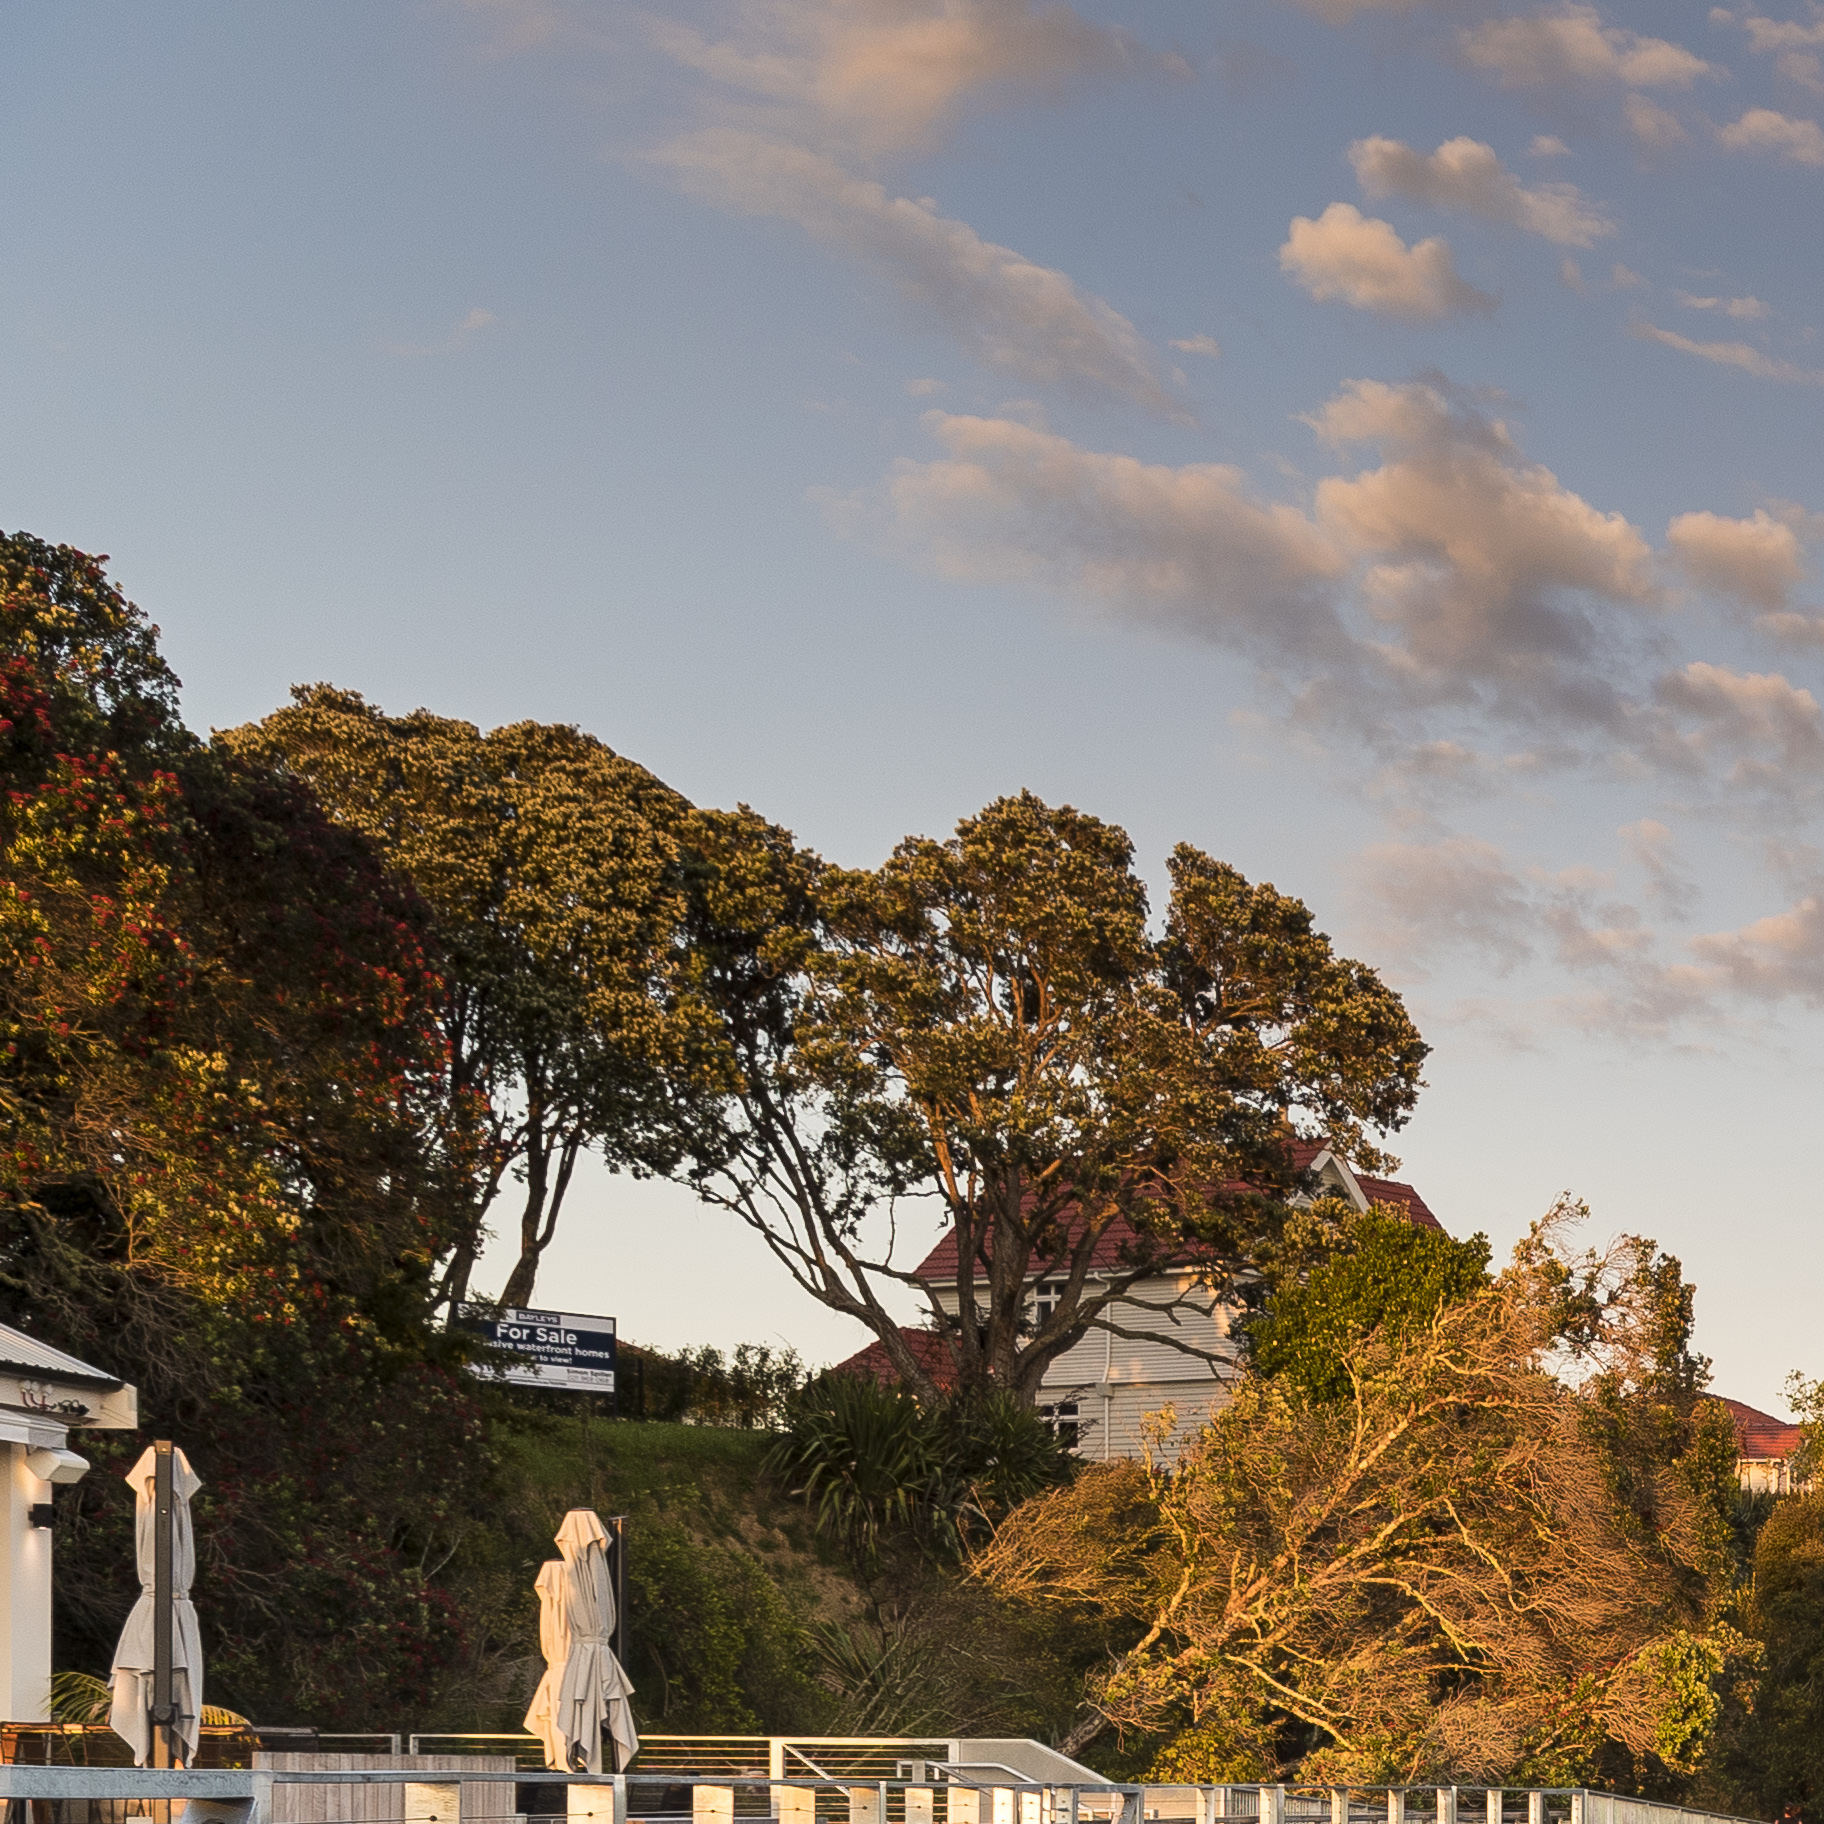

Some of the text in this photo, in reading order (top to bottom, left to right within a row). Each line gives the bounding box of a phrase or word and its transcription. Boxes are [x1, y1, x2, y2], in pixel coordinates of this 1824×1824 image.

[518, 1313, 558, 1324] BAYLEYS
[496, 1323, 578, 1345] For Sale
[517, 1343, 572, 1355] waterfront
[575, 1347, 610, 1359] homes
